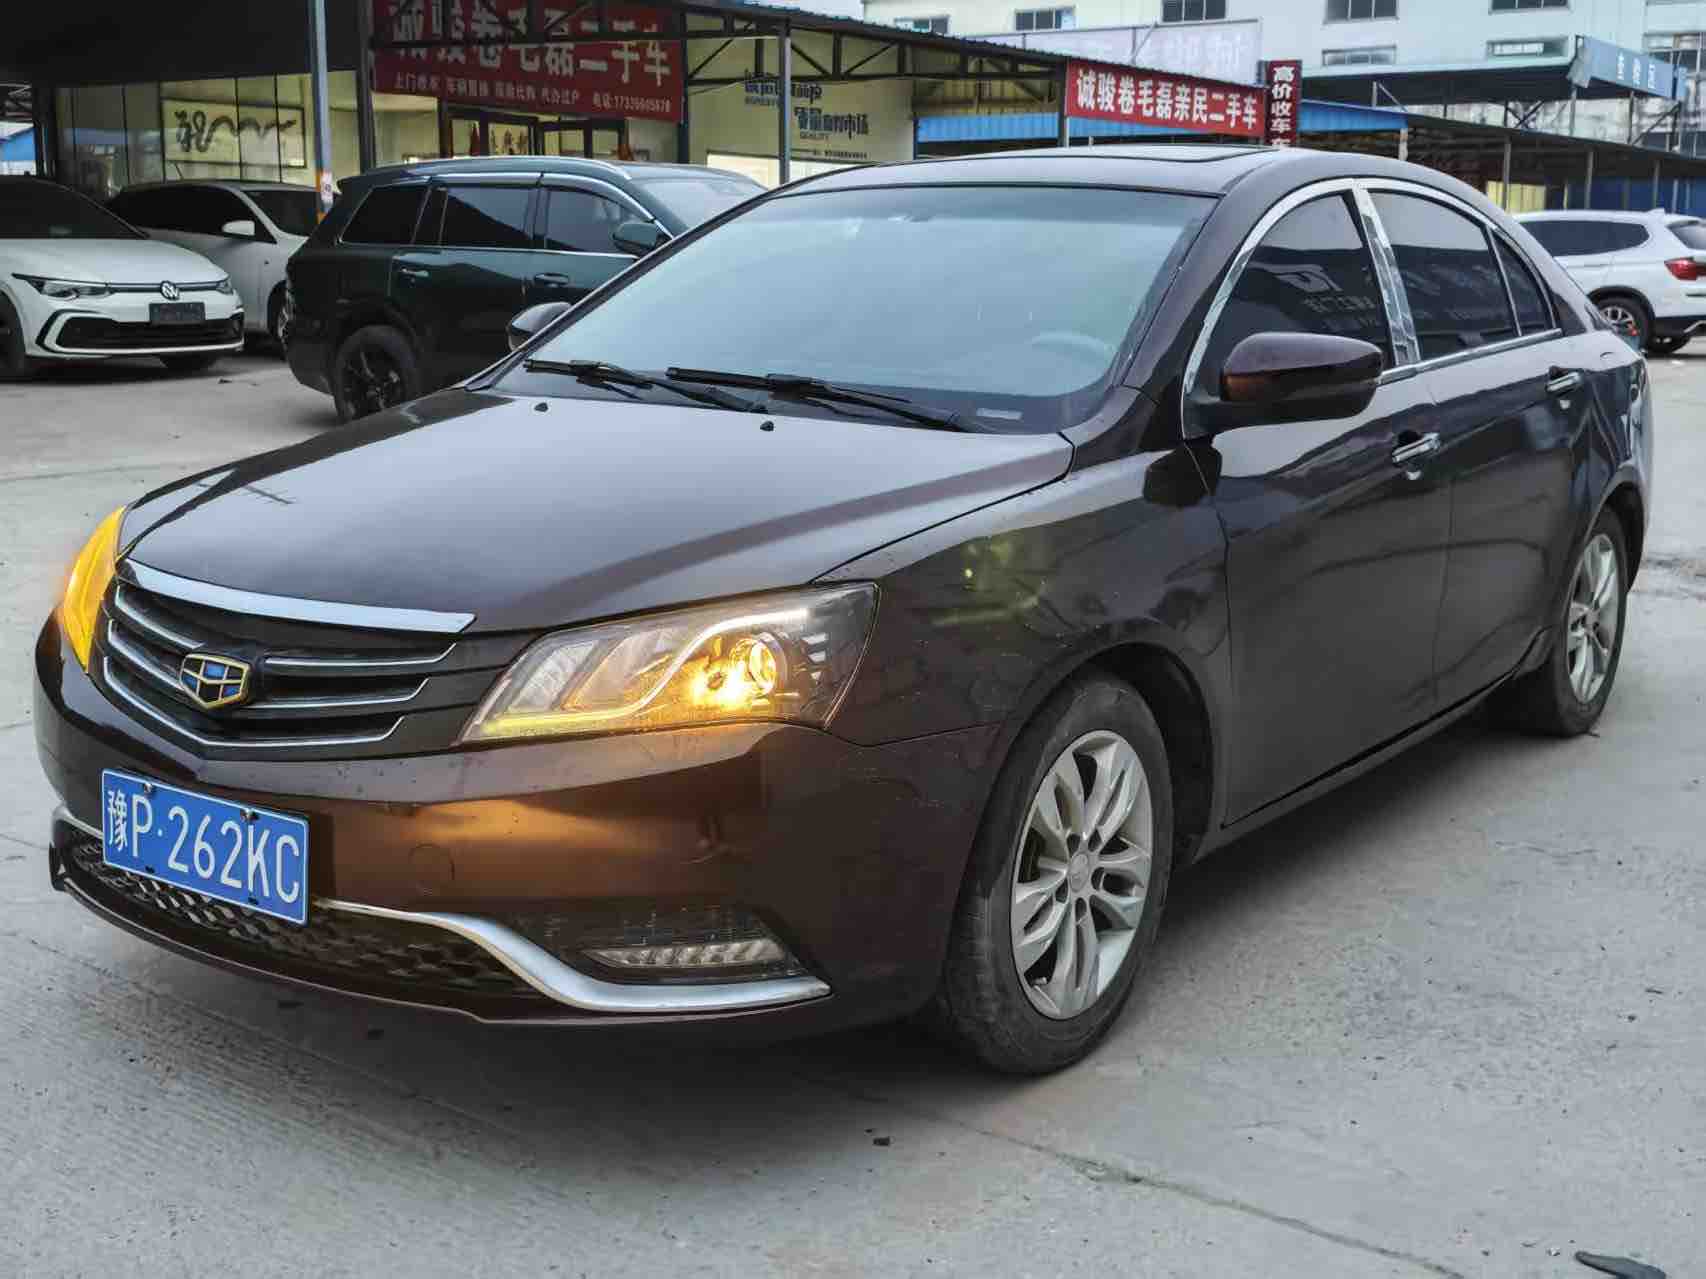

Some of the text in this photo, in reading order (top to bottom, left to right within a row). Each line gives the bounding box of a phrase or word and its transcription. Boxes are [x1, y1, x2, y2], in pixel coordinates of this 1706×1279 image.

[1077, 69, 1257, 129] 诚骏卷毛磊亲民二手车
